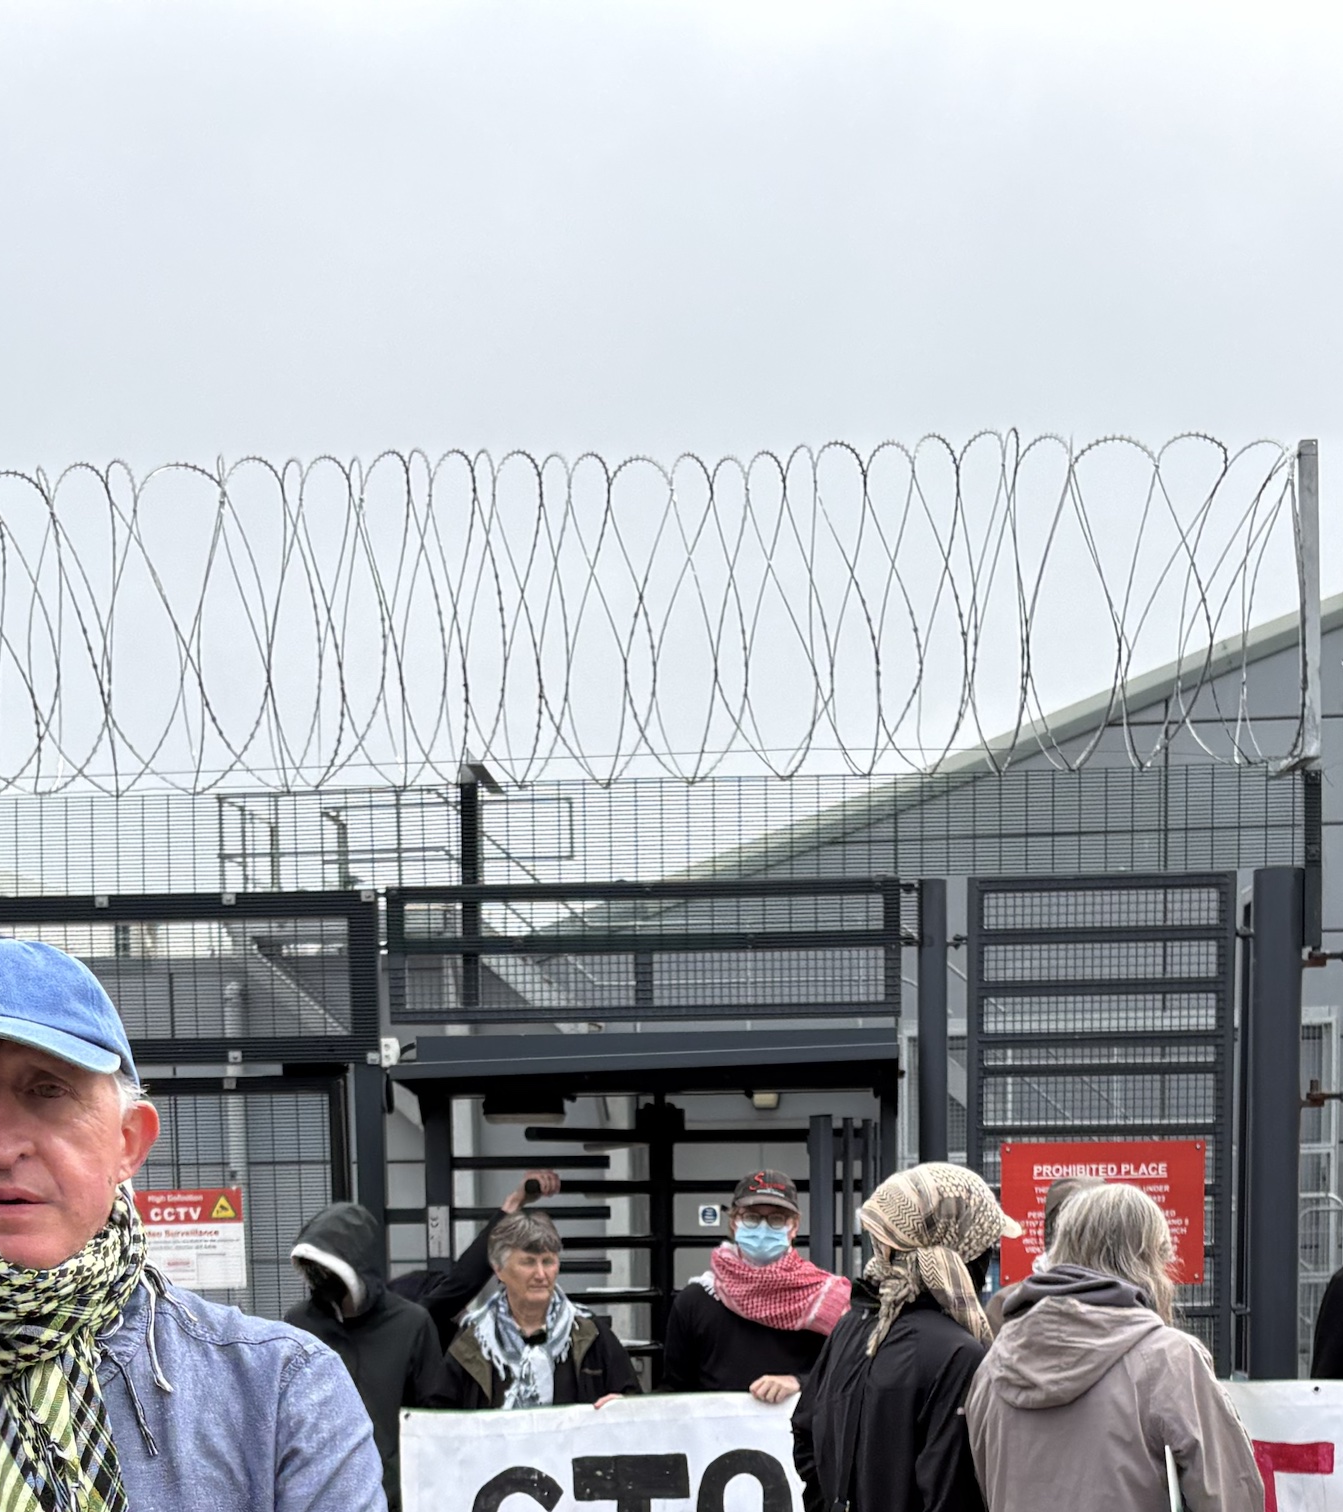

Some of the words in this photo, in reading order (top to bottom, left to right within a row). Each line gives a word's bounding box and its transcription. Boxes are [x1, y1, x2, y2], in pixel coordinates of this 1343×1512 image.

[1033, 1164, 1117, 1178] PROHIBITED
[1121, 1163, 1167, 1176] PLACE
[150, 1208, 201, 1221] CCTV
